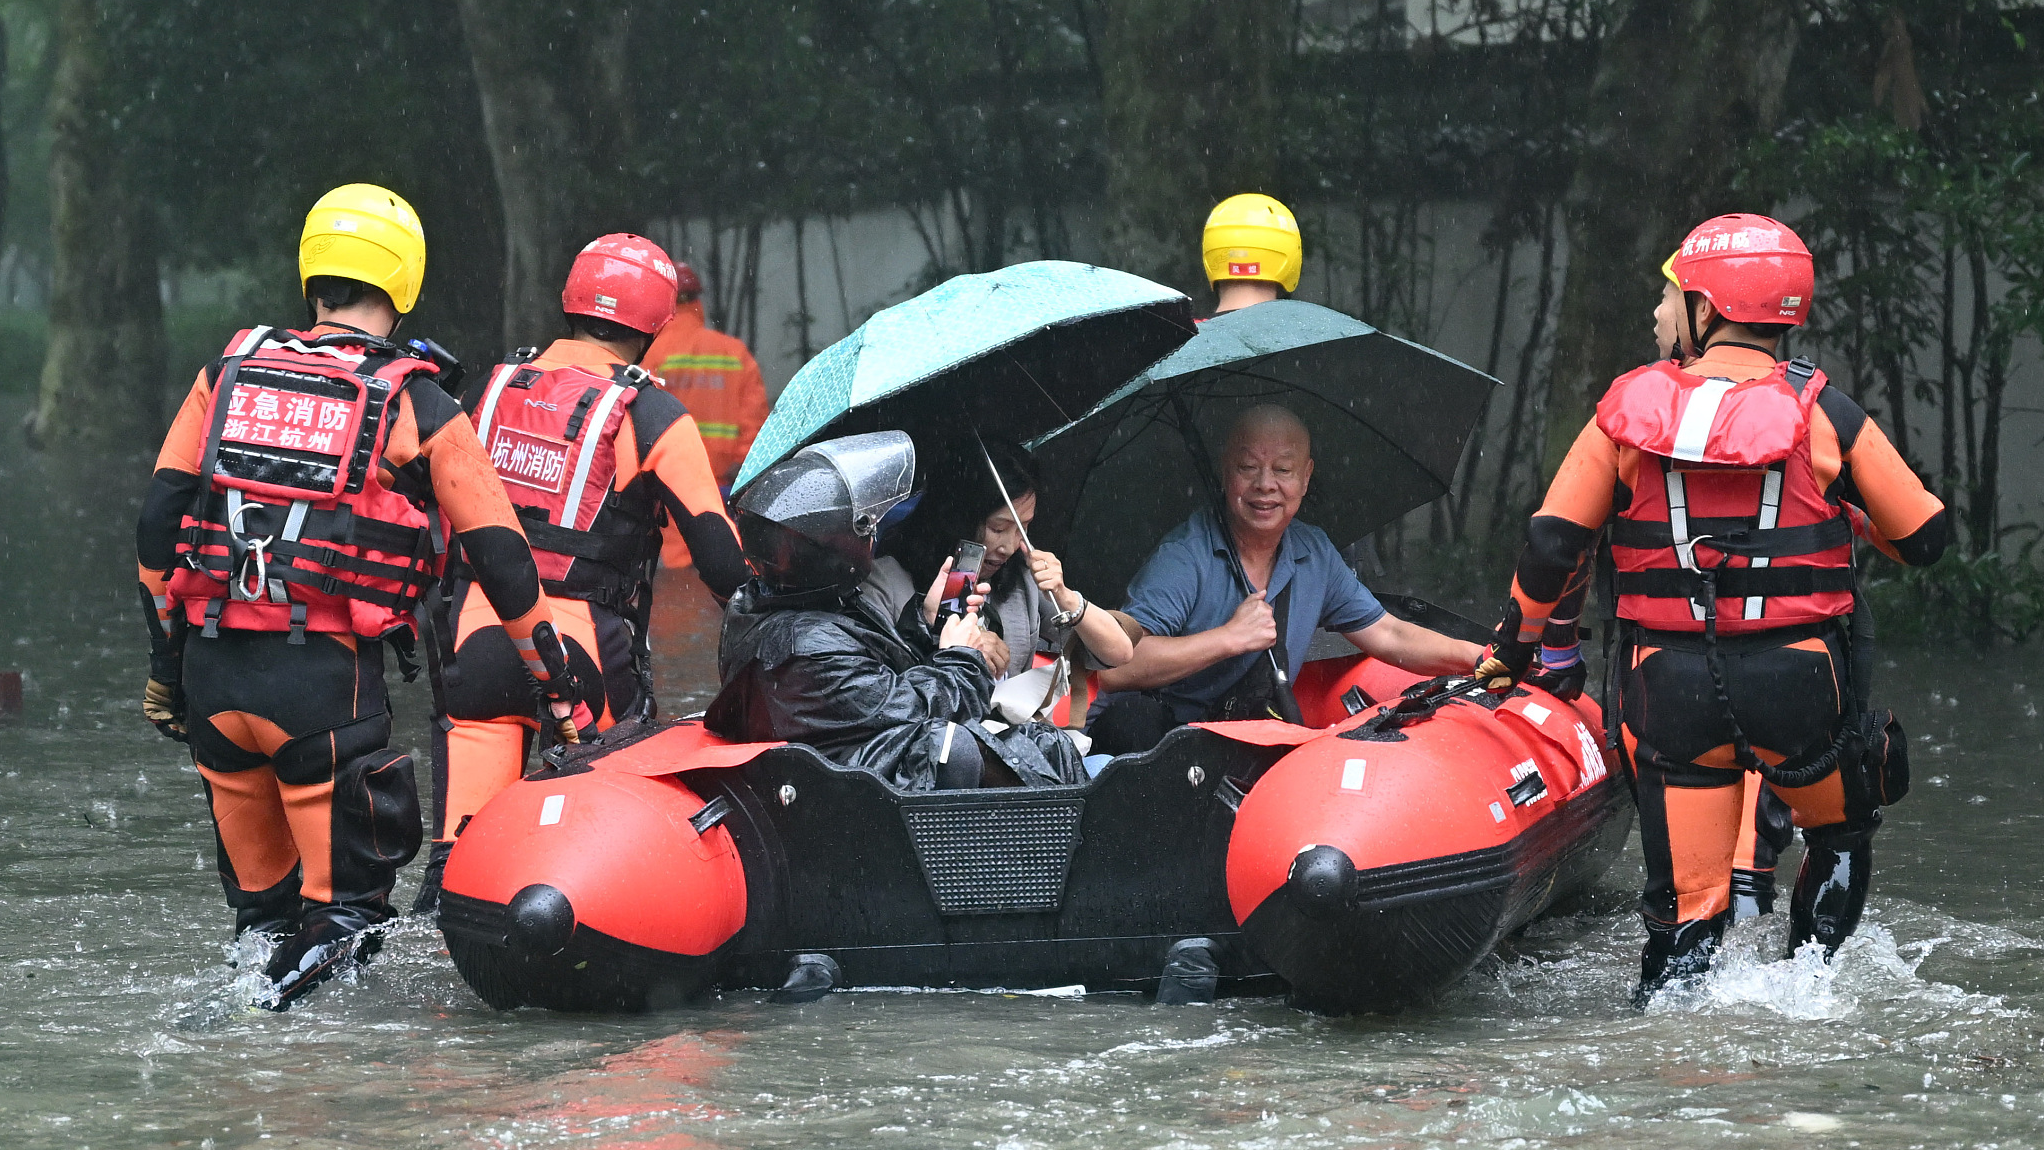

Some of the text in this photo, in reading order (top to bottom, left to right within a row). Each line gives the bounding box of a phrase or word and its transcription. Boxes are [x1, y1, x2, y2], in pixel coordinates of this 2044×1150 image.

[1682, 231, 1750, 257] 杭州消防
[594, 305, 616, 315] NRS
[227, 387, 350, 431] 应急消防
[523, 398, 558, 412] NRS
[222, 418, 334, 452] 浙江杭州
[493, 436, 564, 482] 杭州消防
